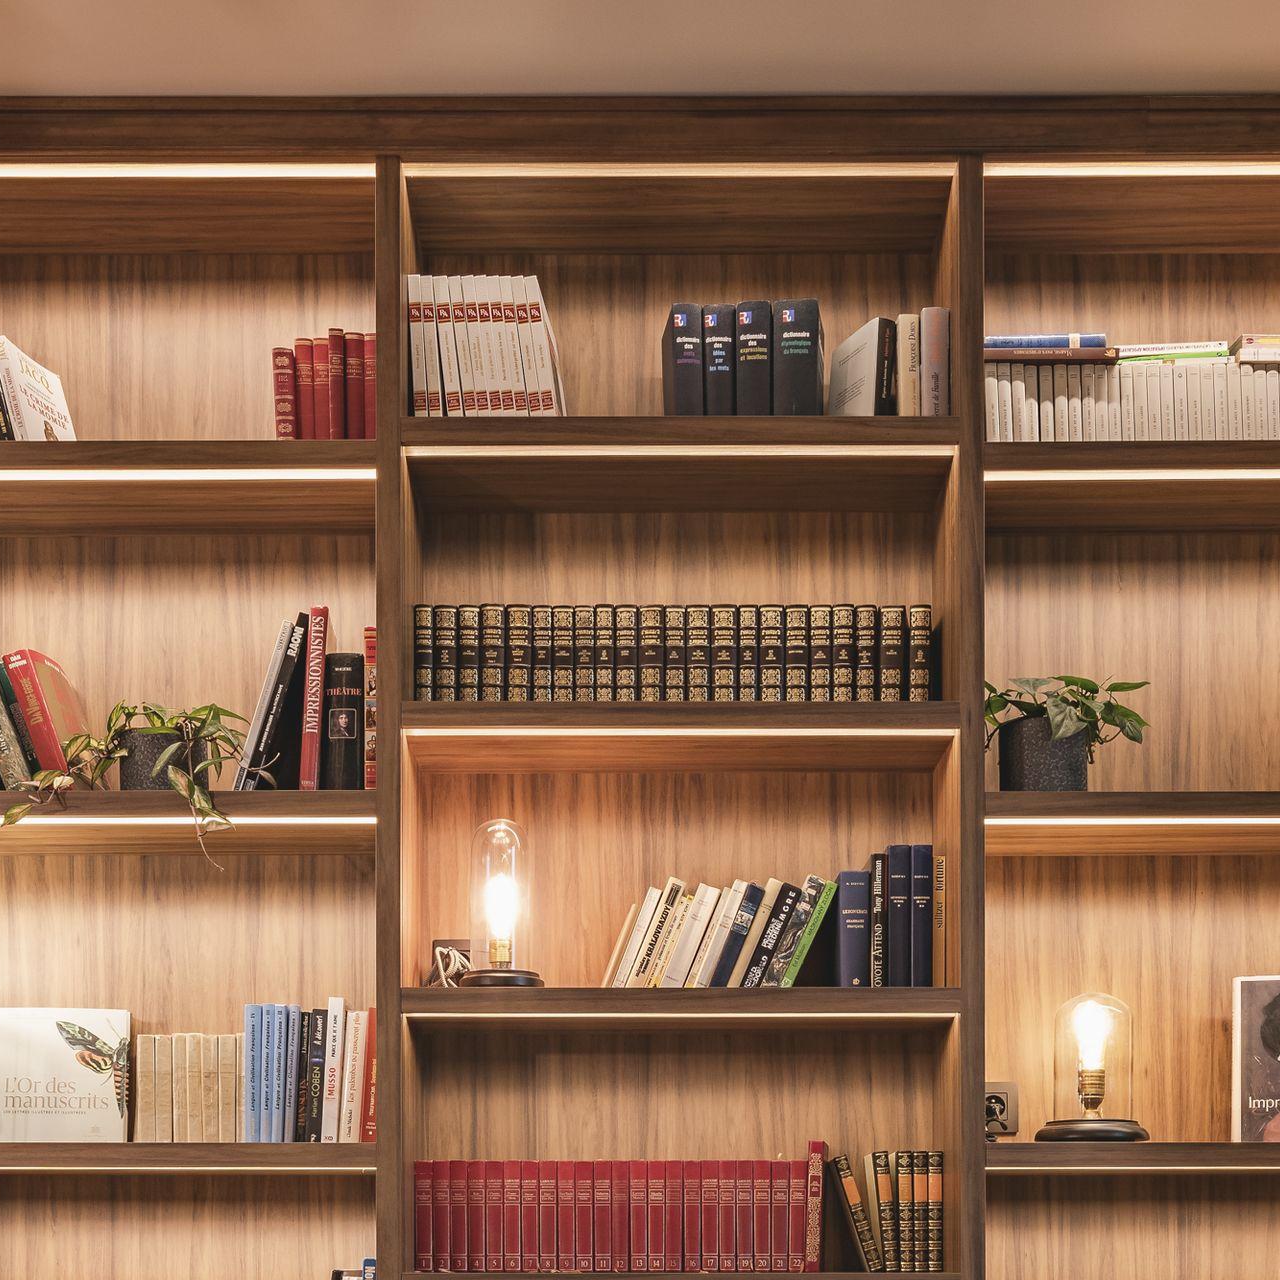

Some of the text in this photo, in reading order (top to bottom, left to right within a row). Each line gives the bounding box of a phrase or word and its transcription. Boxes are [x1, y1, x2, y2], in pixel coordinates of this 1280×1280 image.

[706, 336, 732, 344] dictionnaire
[783, 331, 810, 339] dictionnaire
[908, 321, 917, 373] FRANÇOISE DORIN
[20, 358, 54, 395] JACQ
[287, 626, 304, 657] RAONI
[10, 654, 22, 662] DAN
[306, 615, 324, 734] IMPRESSIONNISTES
[327, 687, 362, 696] THÉÂTRE
[873, 860, 883, 914] Tony Hillerman
[934, 859, 944, 929] sulitzer fortune
[348, 1064, 357, 1091] palombes
[353, 1013, 361, 1025] plus
[4, 1077, 77, 1094] L'Or des
[312, 1066, 321, 1097] COBEN
[328, 1067, 336, 1096] MUSSO
[4, 1092, 110, 1110] manuscrits
